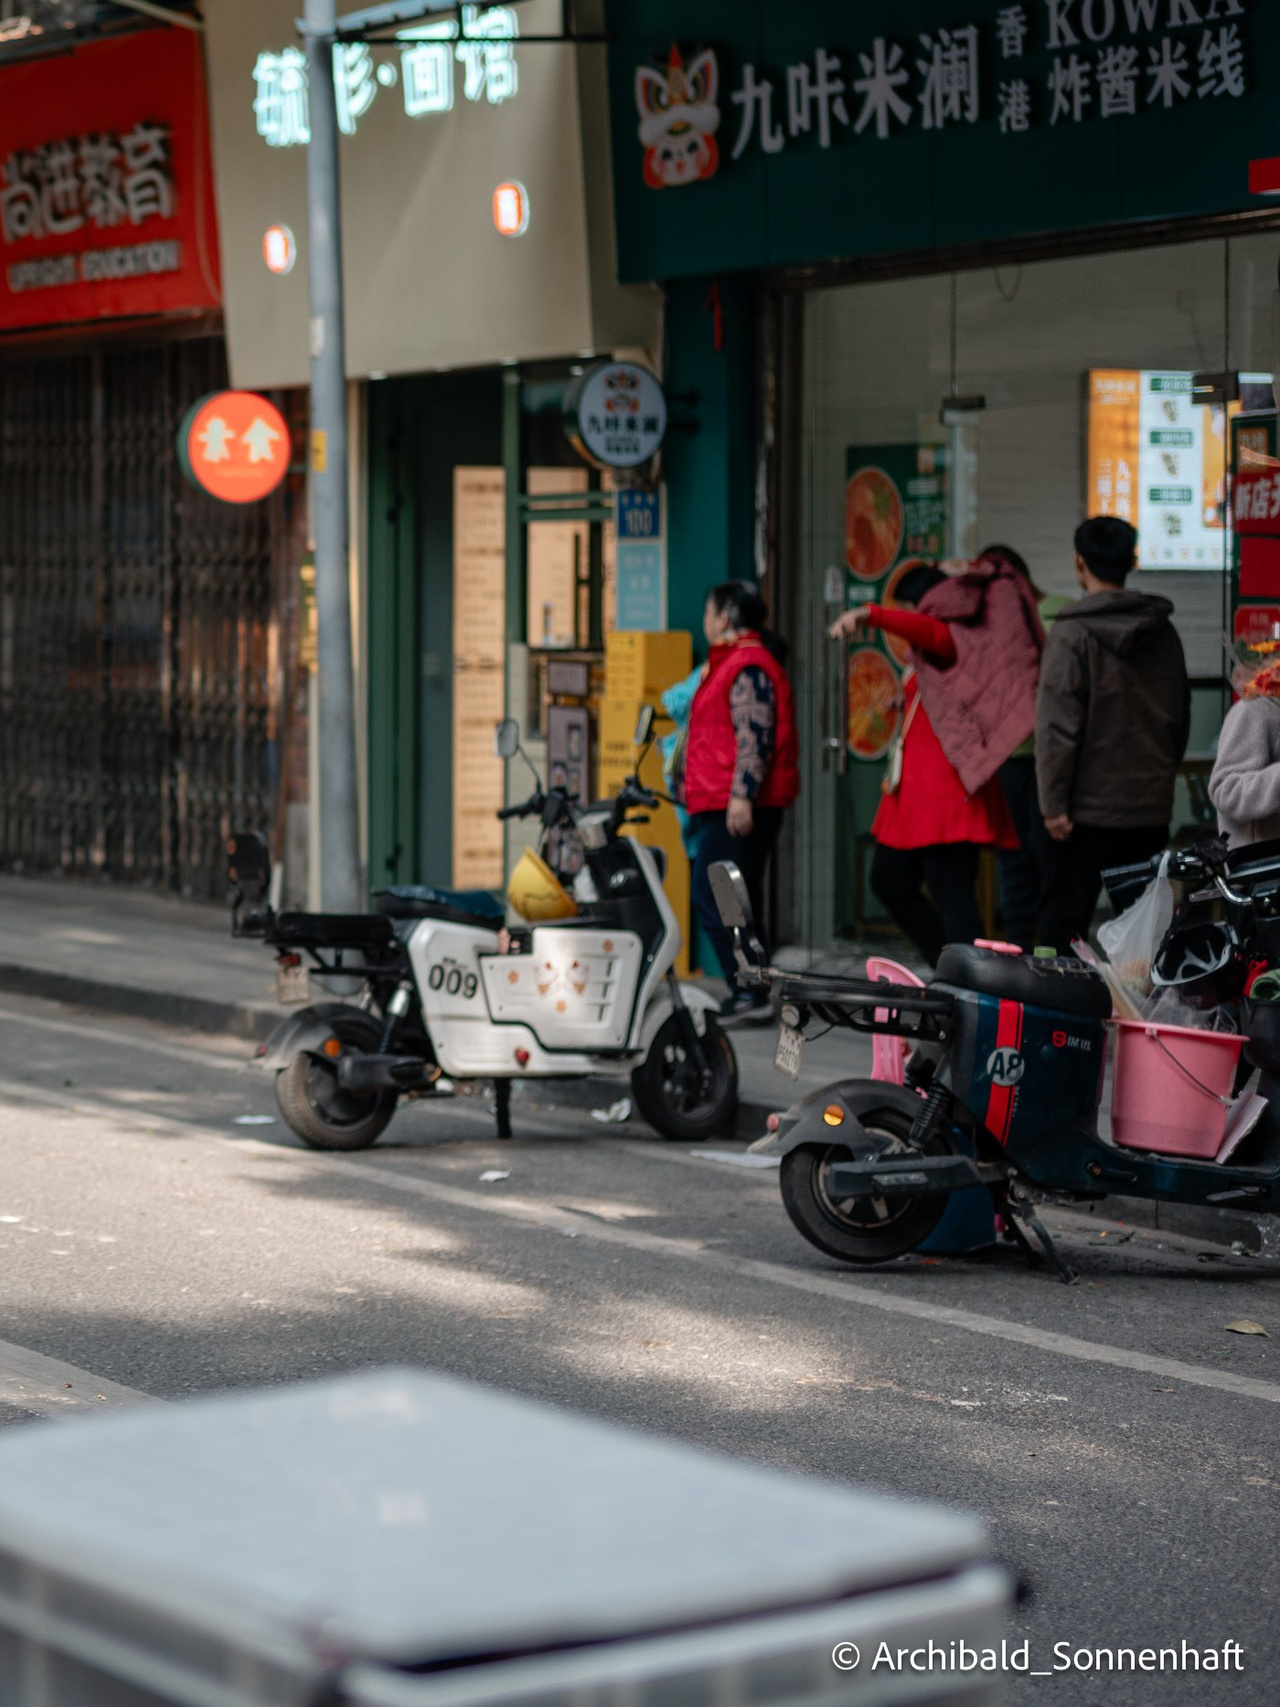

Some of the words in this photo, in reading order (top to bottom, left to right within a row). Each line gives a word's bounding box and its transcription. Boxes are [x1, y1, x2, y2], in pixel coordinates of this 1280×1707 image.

[731, 25, 979, 160] 九咔米澜
[997, 7, 1030, 134] 香港
[1047, 26, 1245, 125] 炸酱米线
[428, 963, 479, 999] 009
[989, 1051, 1023, 1080] A8
